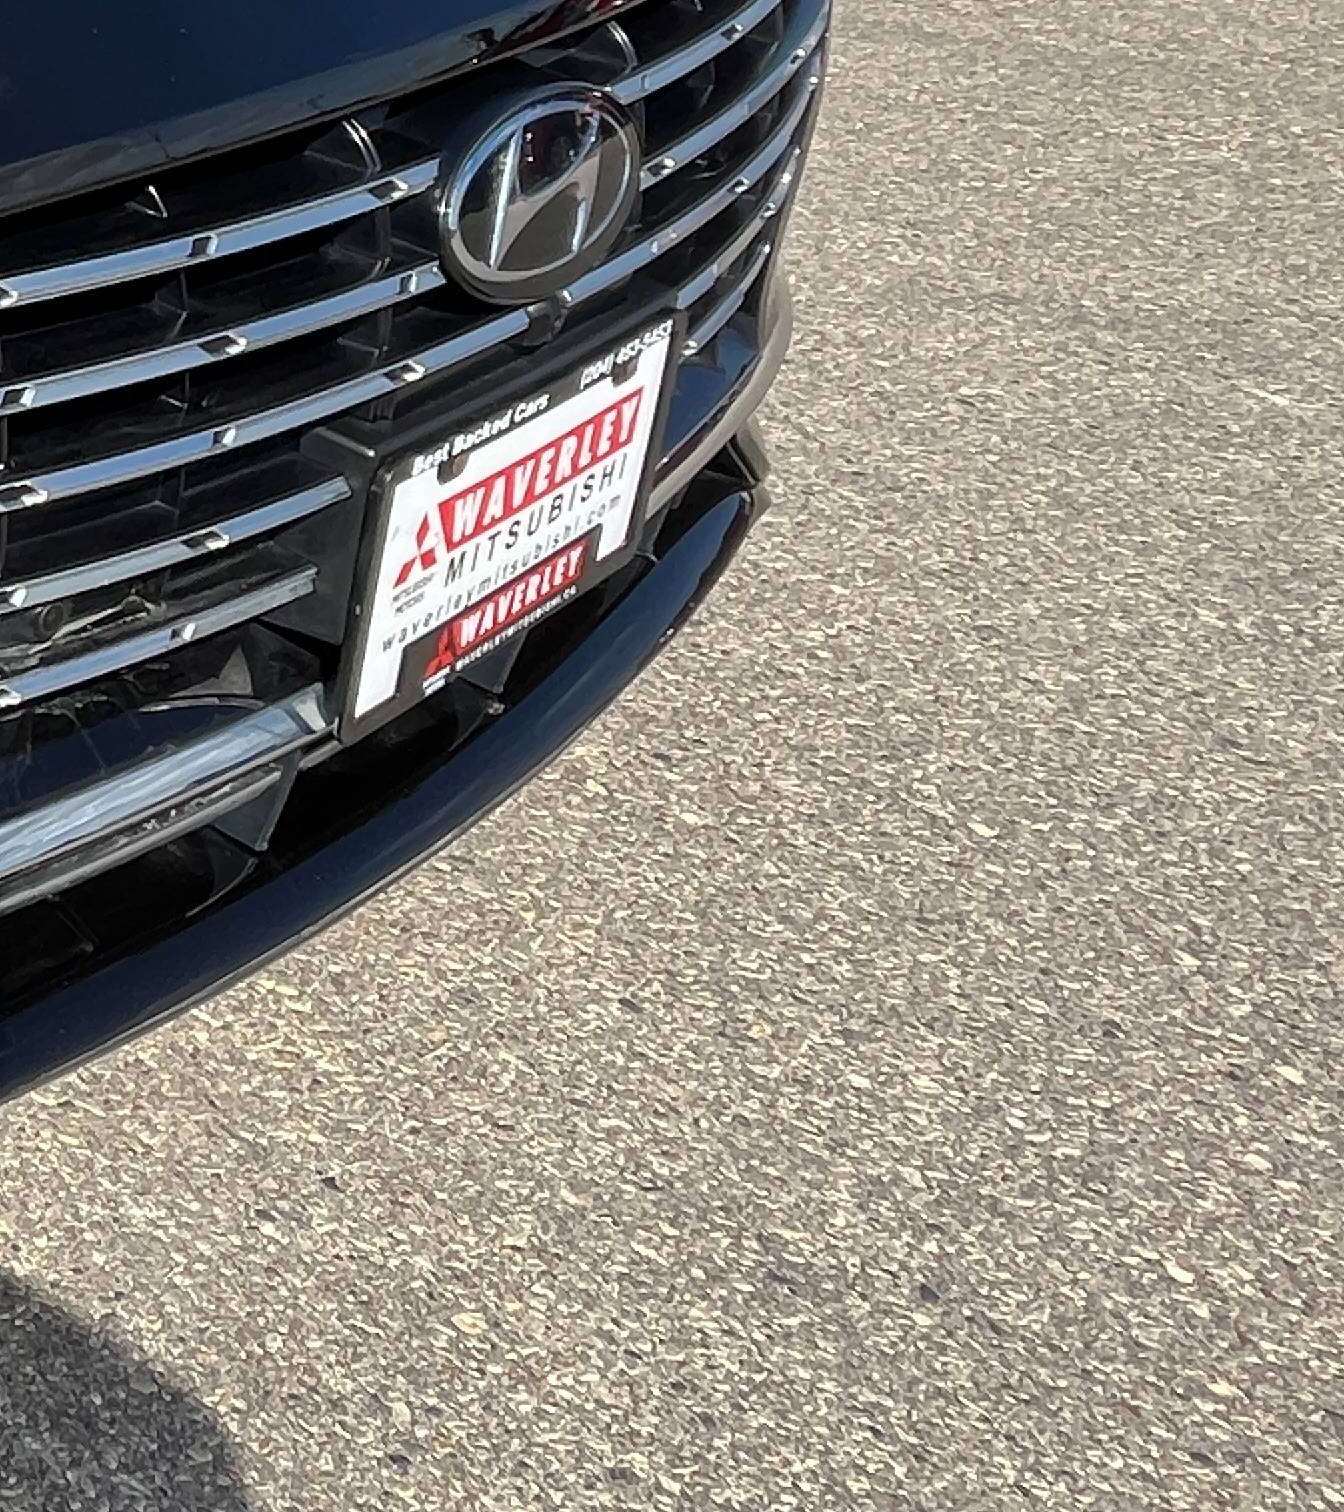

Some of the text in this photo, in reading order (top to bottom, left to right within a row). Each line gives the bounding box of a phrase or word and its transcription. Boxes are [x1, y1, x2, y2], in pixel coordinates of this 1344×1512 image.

[514, 394, 550, 423] Cars
[444, 452, 627, 588] MITSUBISHI
[451, 399, 640, 543] WAVERLEY
[460, 544, 584, 648] WAVERLEY
